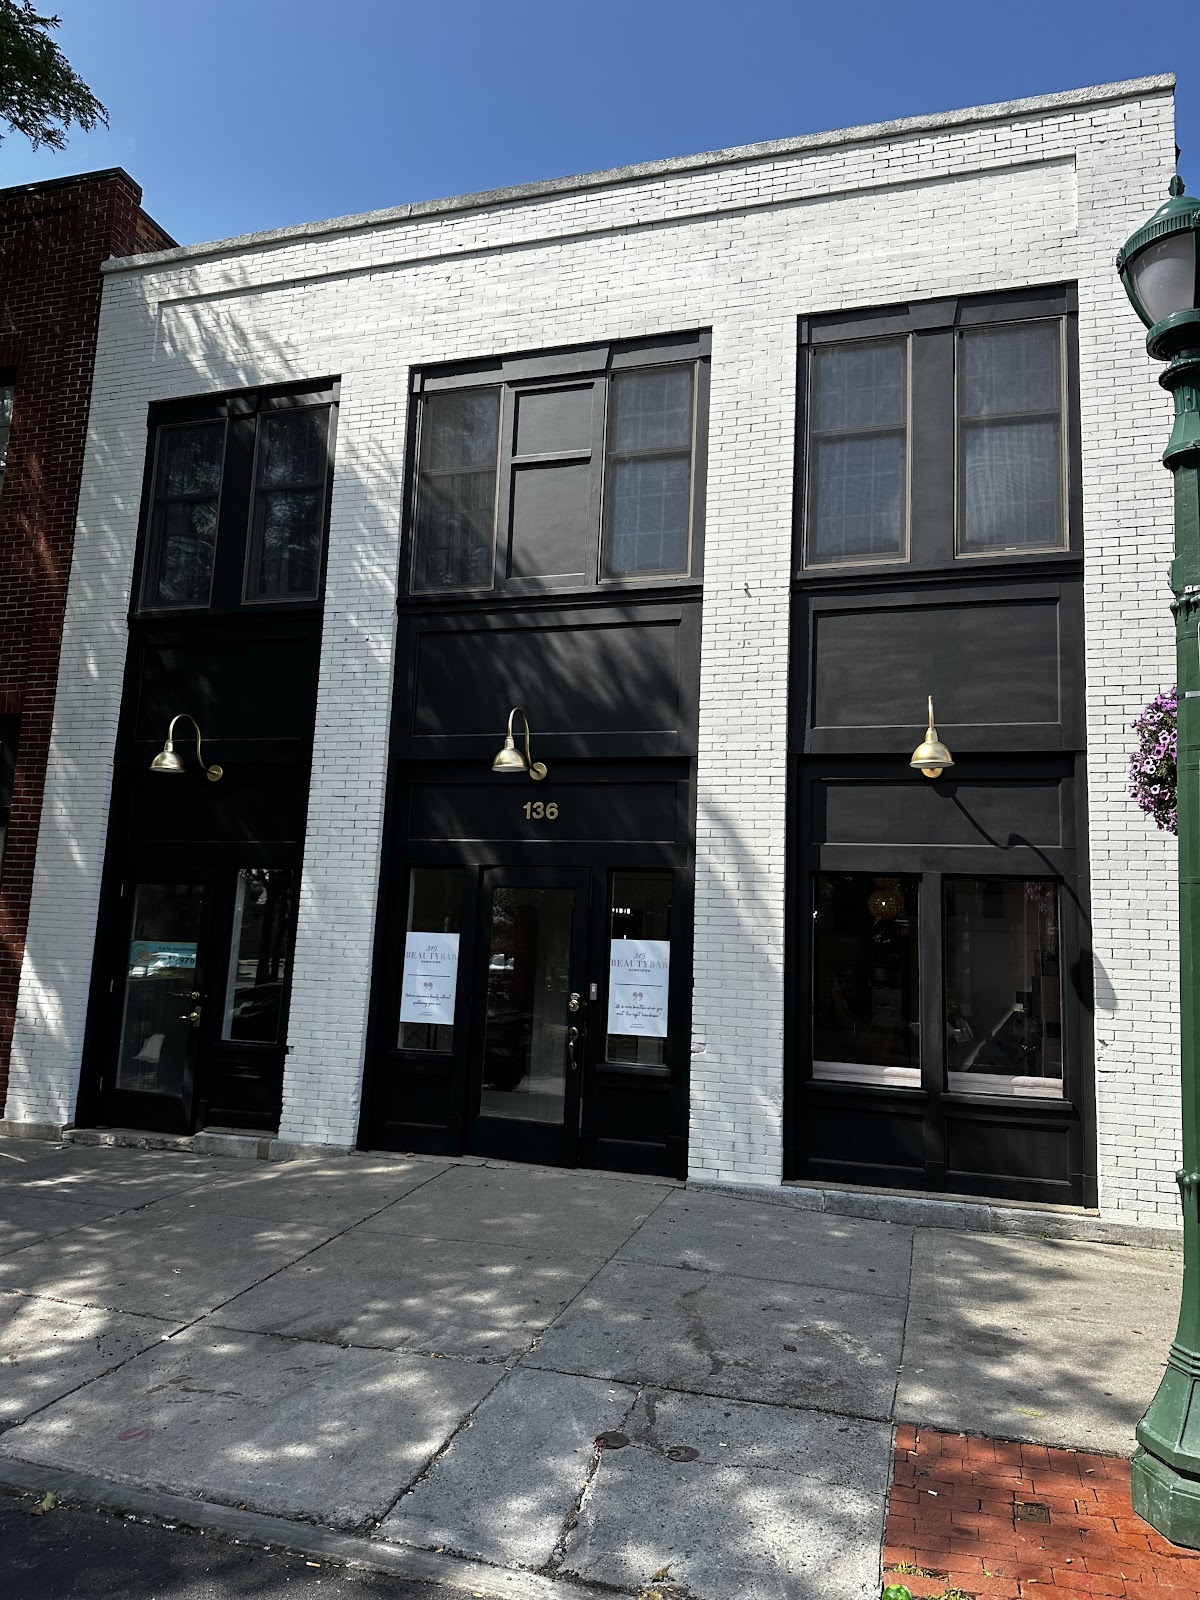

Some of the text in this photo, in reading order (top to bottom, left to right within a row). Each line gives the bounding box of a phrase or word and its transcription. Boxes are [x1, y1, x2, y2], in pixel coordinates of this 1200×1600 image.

[523, 801, 559, 820] 136
[406, 952, 457, 960] BEAUTYBAR
[633, 952, 647, 960] 315
[611, 959, 668, 969] BEAUTYBAR
